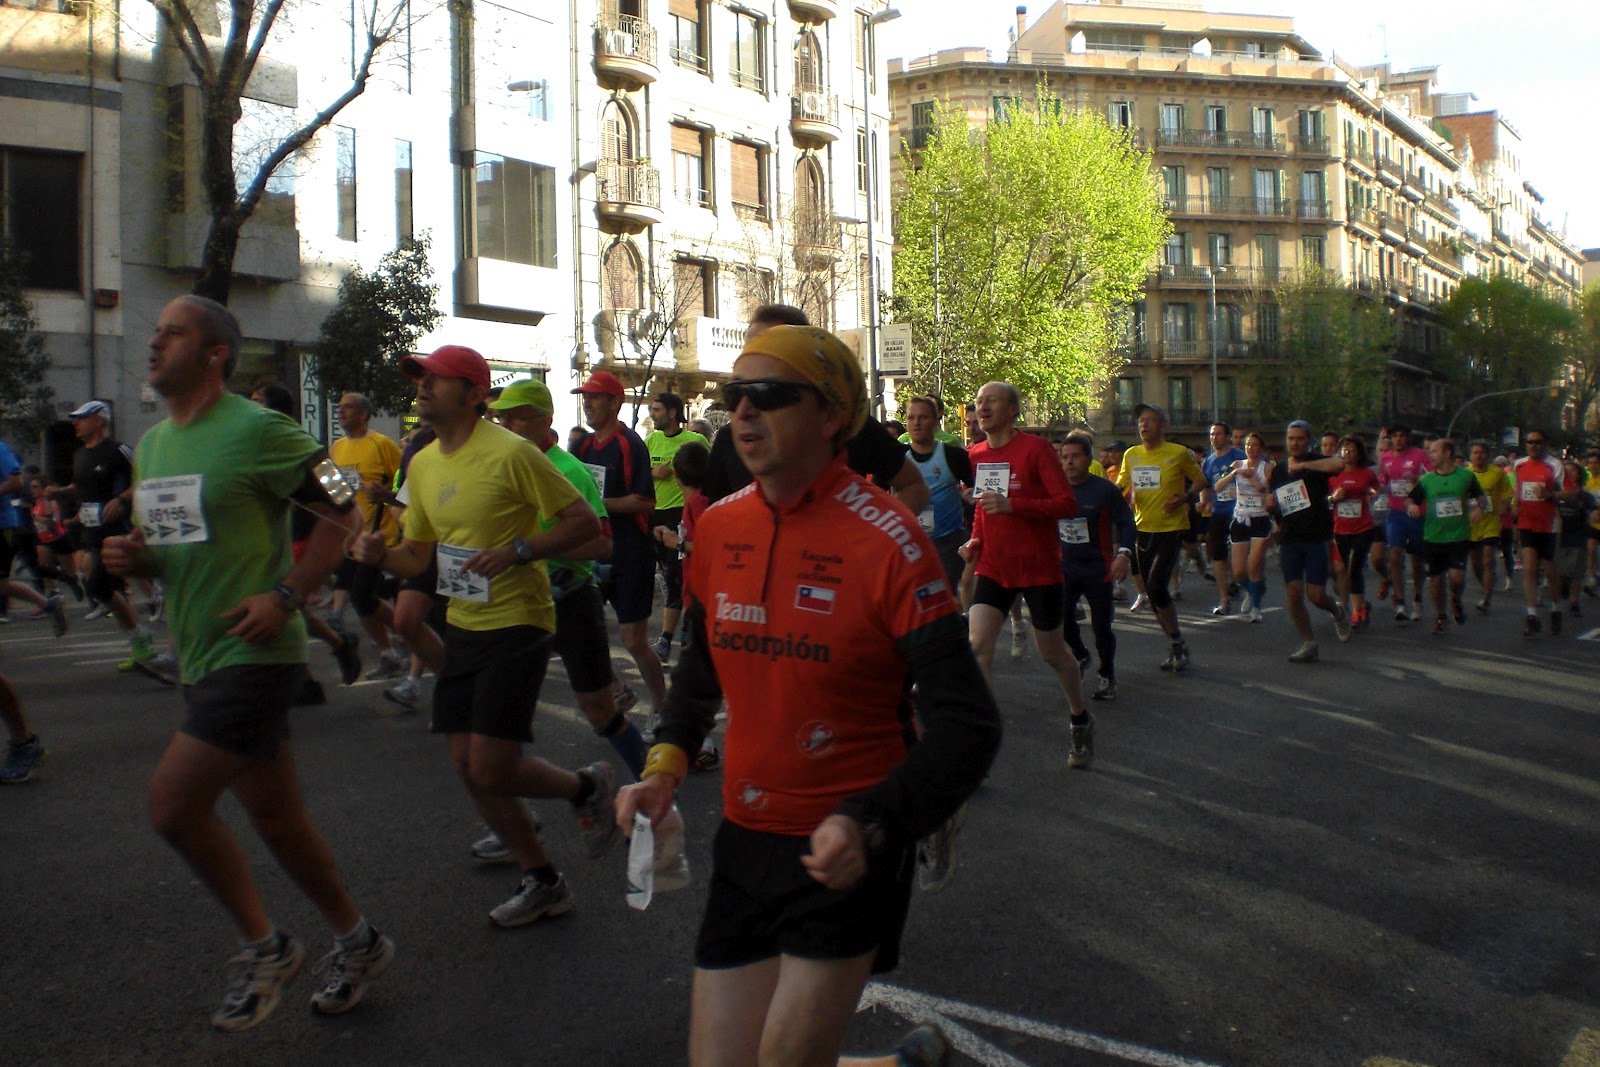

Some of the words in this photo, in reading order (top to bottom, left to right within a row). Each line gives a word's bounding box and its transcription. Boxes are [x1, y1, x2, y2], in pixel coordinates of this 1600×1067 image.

[834, 481, 923, 564] Molina
[715, 592, 768, 624] Team
[712, 621, 832, 663] Escorpión
